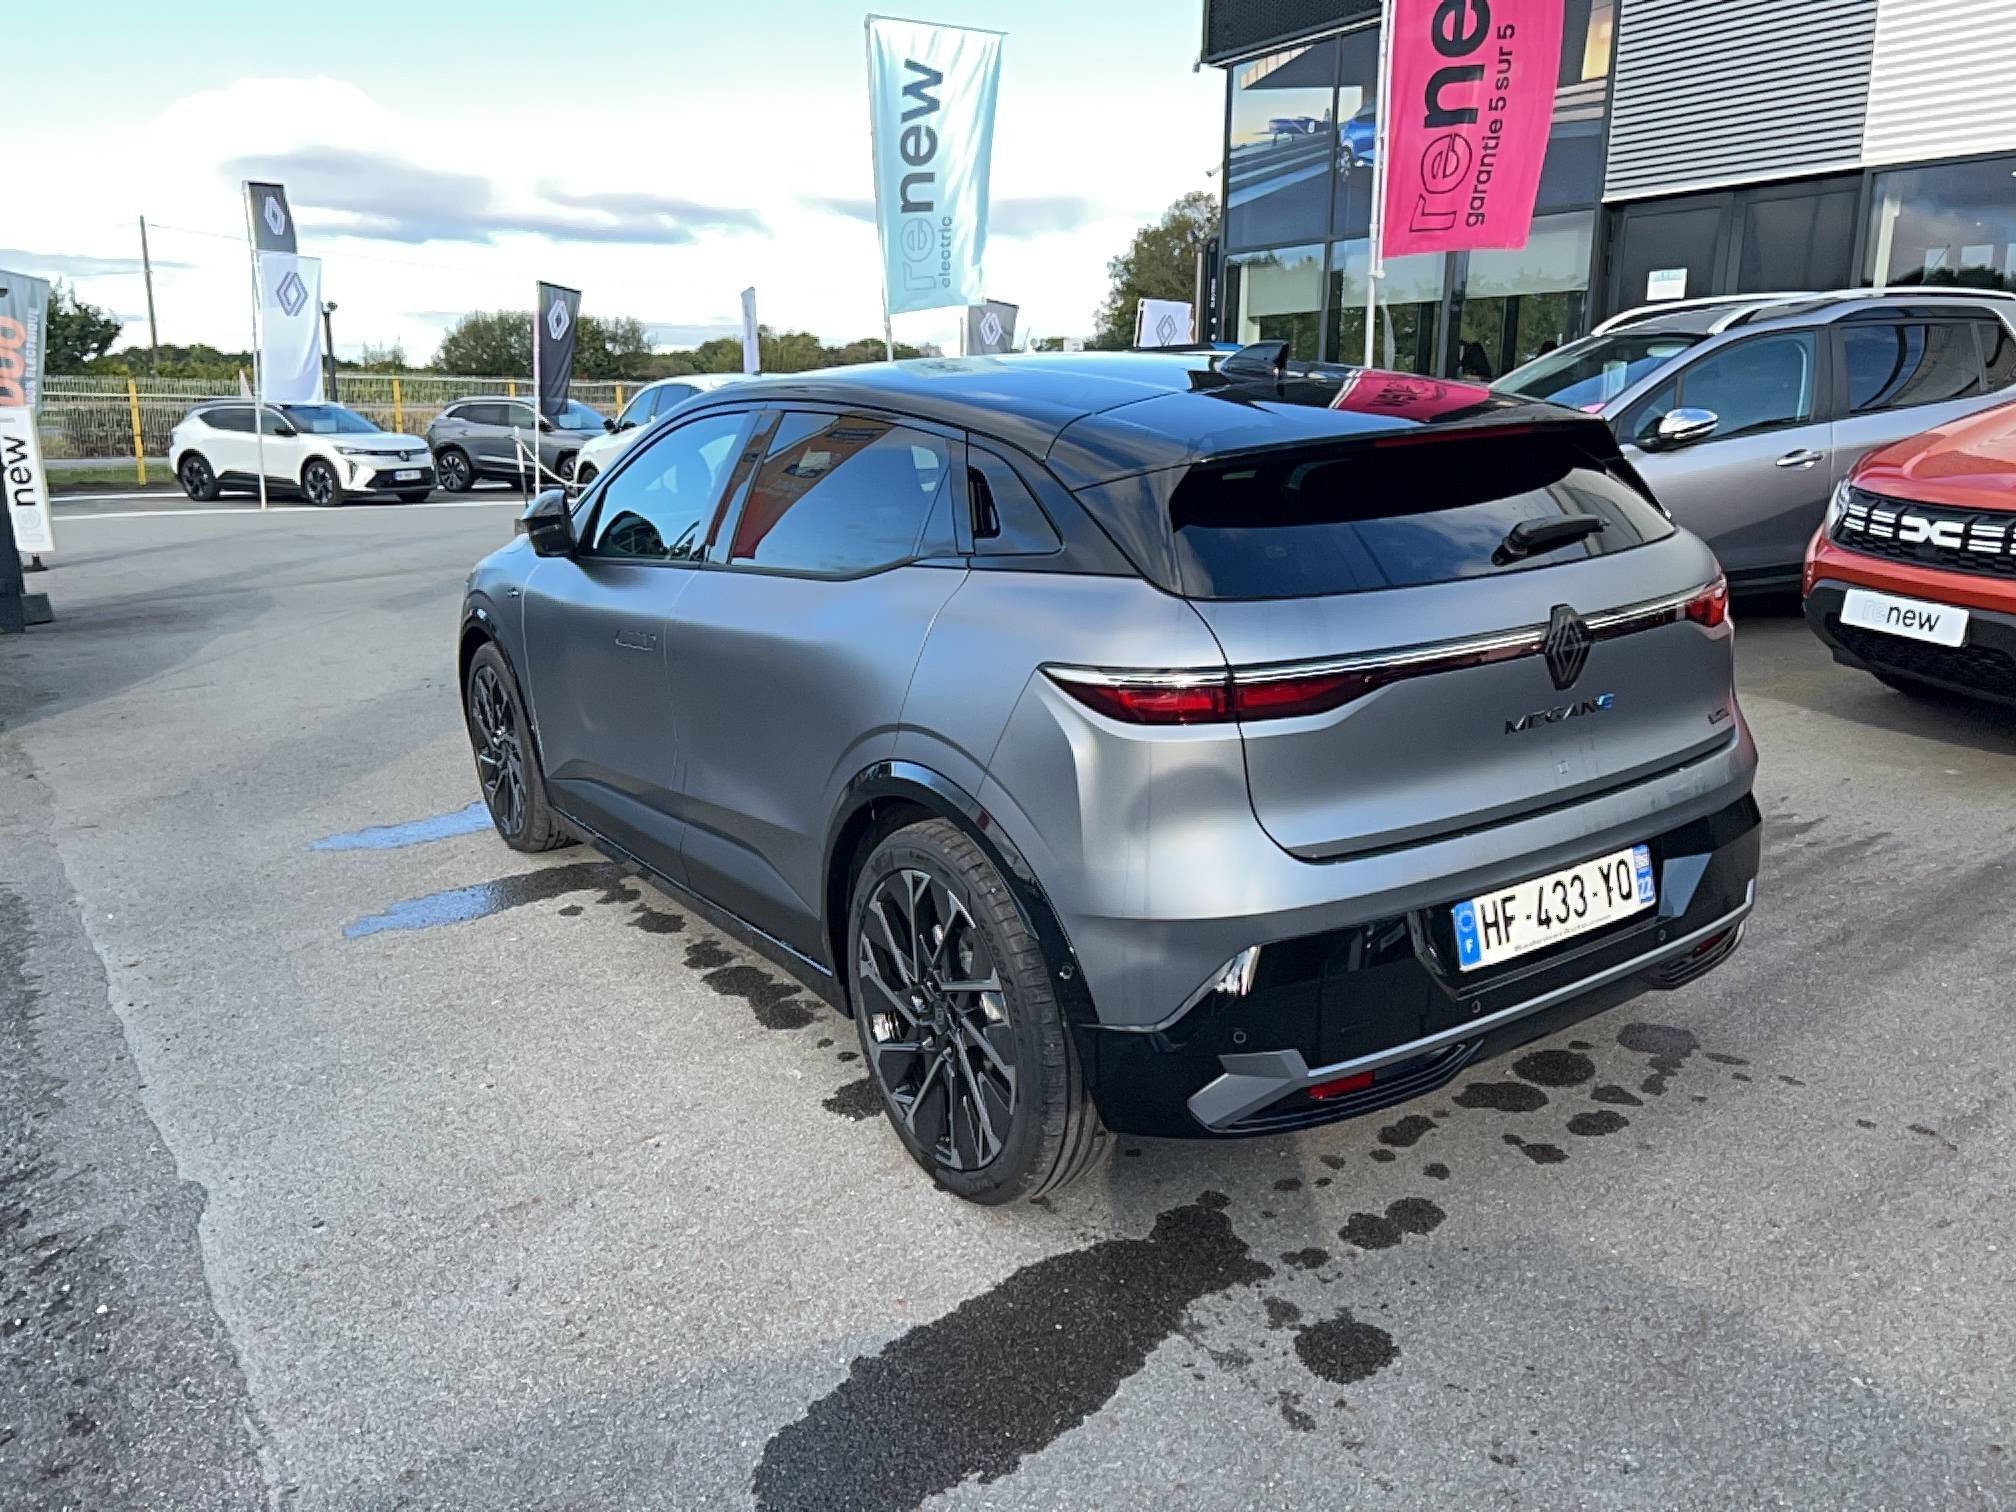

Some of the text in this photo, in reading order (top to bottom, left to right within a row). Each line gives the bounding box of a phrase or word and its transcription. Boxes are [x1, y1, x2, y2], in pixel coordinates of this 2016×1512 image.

[899, 58, 944, 291] renew
[1465, 24, 1515, 228] garantie 5 sur 5
[938, 215, 953, 288] electric
[1465, 938, 1474, 955] F
